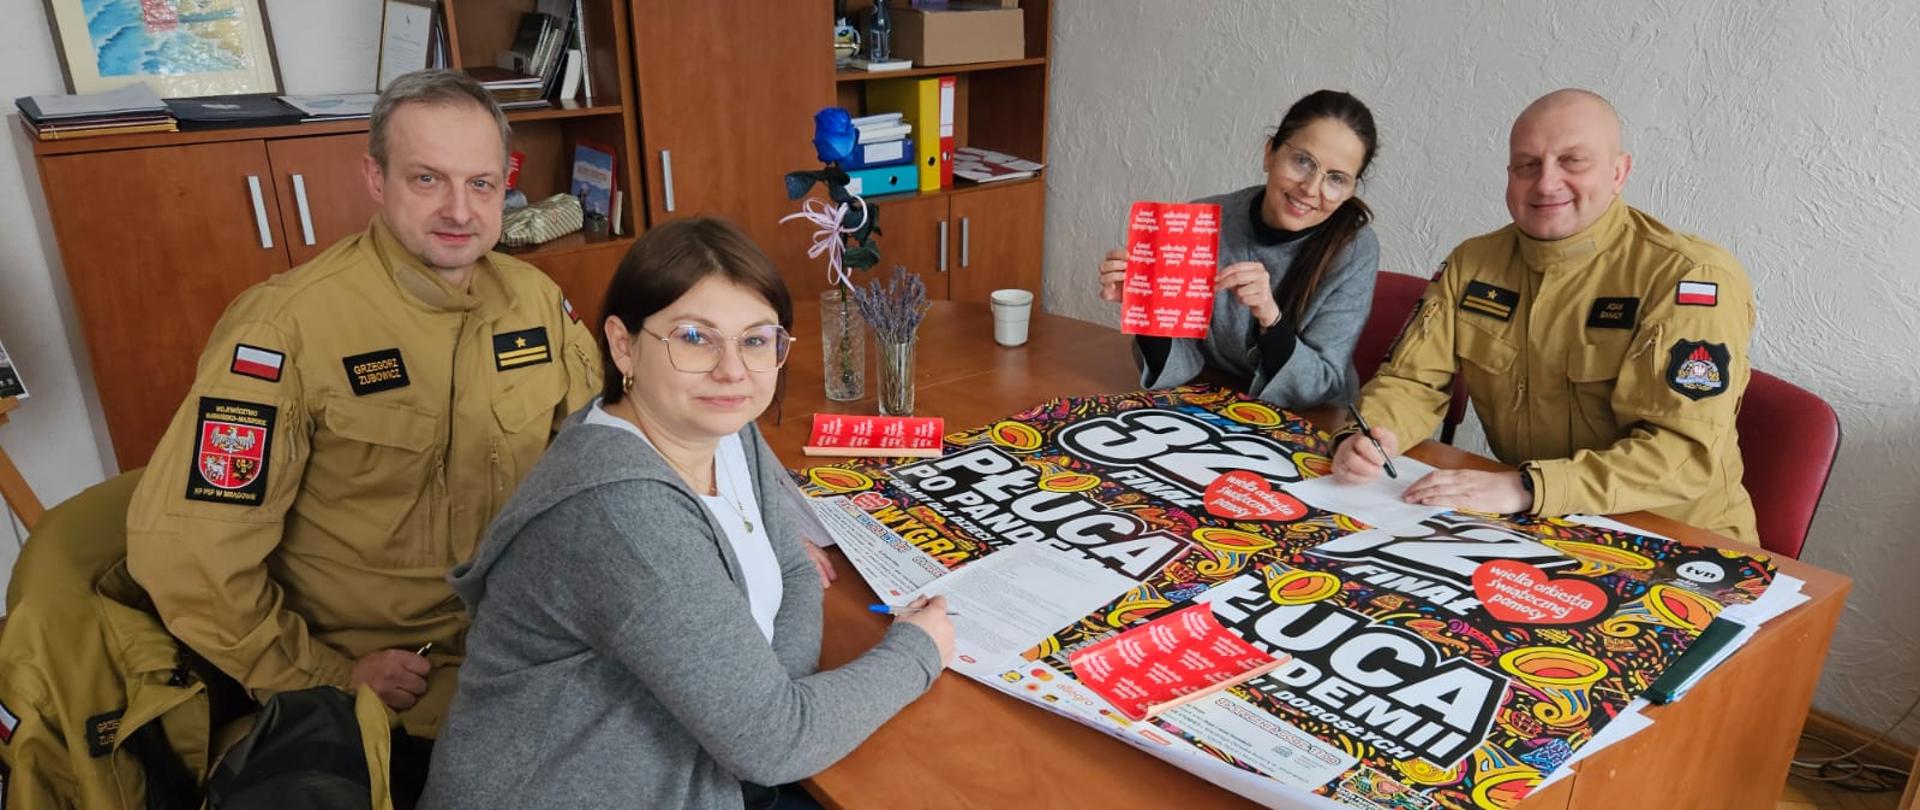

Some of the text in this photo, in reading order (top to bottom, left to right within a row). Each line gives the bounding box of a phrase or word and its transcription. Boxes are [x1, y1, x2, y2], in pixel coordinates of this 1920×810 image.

[353, 358, 399, 375] GRZEGORZ
[358, 369, 402, 385] ZUBOWICZ
[1072, 413, 1302, 487] 32
[889, 479, 936, 501] GRAMY
[926, 502, 956, 516] DLA
[898, 464, 957, 491] PO
[934, 449, 1182, 577] PŁUCA
[871, 504, 970, 567] WYGRA
[1342, 565, 1484, 615] FINAŁ
[1489, 566, 1593, 611] wielka orkiestra
[1686, 566, 1716, 578] tvn
[1486, 578, 1574, 619] świątecznej
[1488, 594, 1547, 620] pomocy
[1192, 574, 1494, 733] ŁUCA
[1273, 691, 1414, 758] DOROSŁYCH
